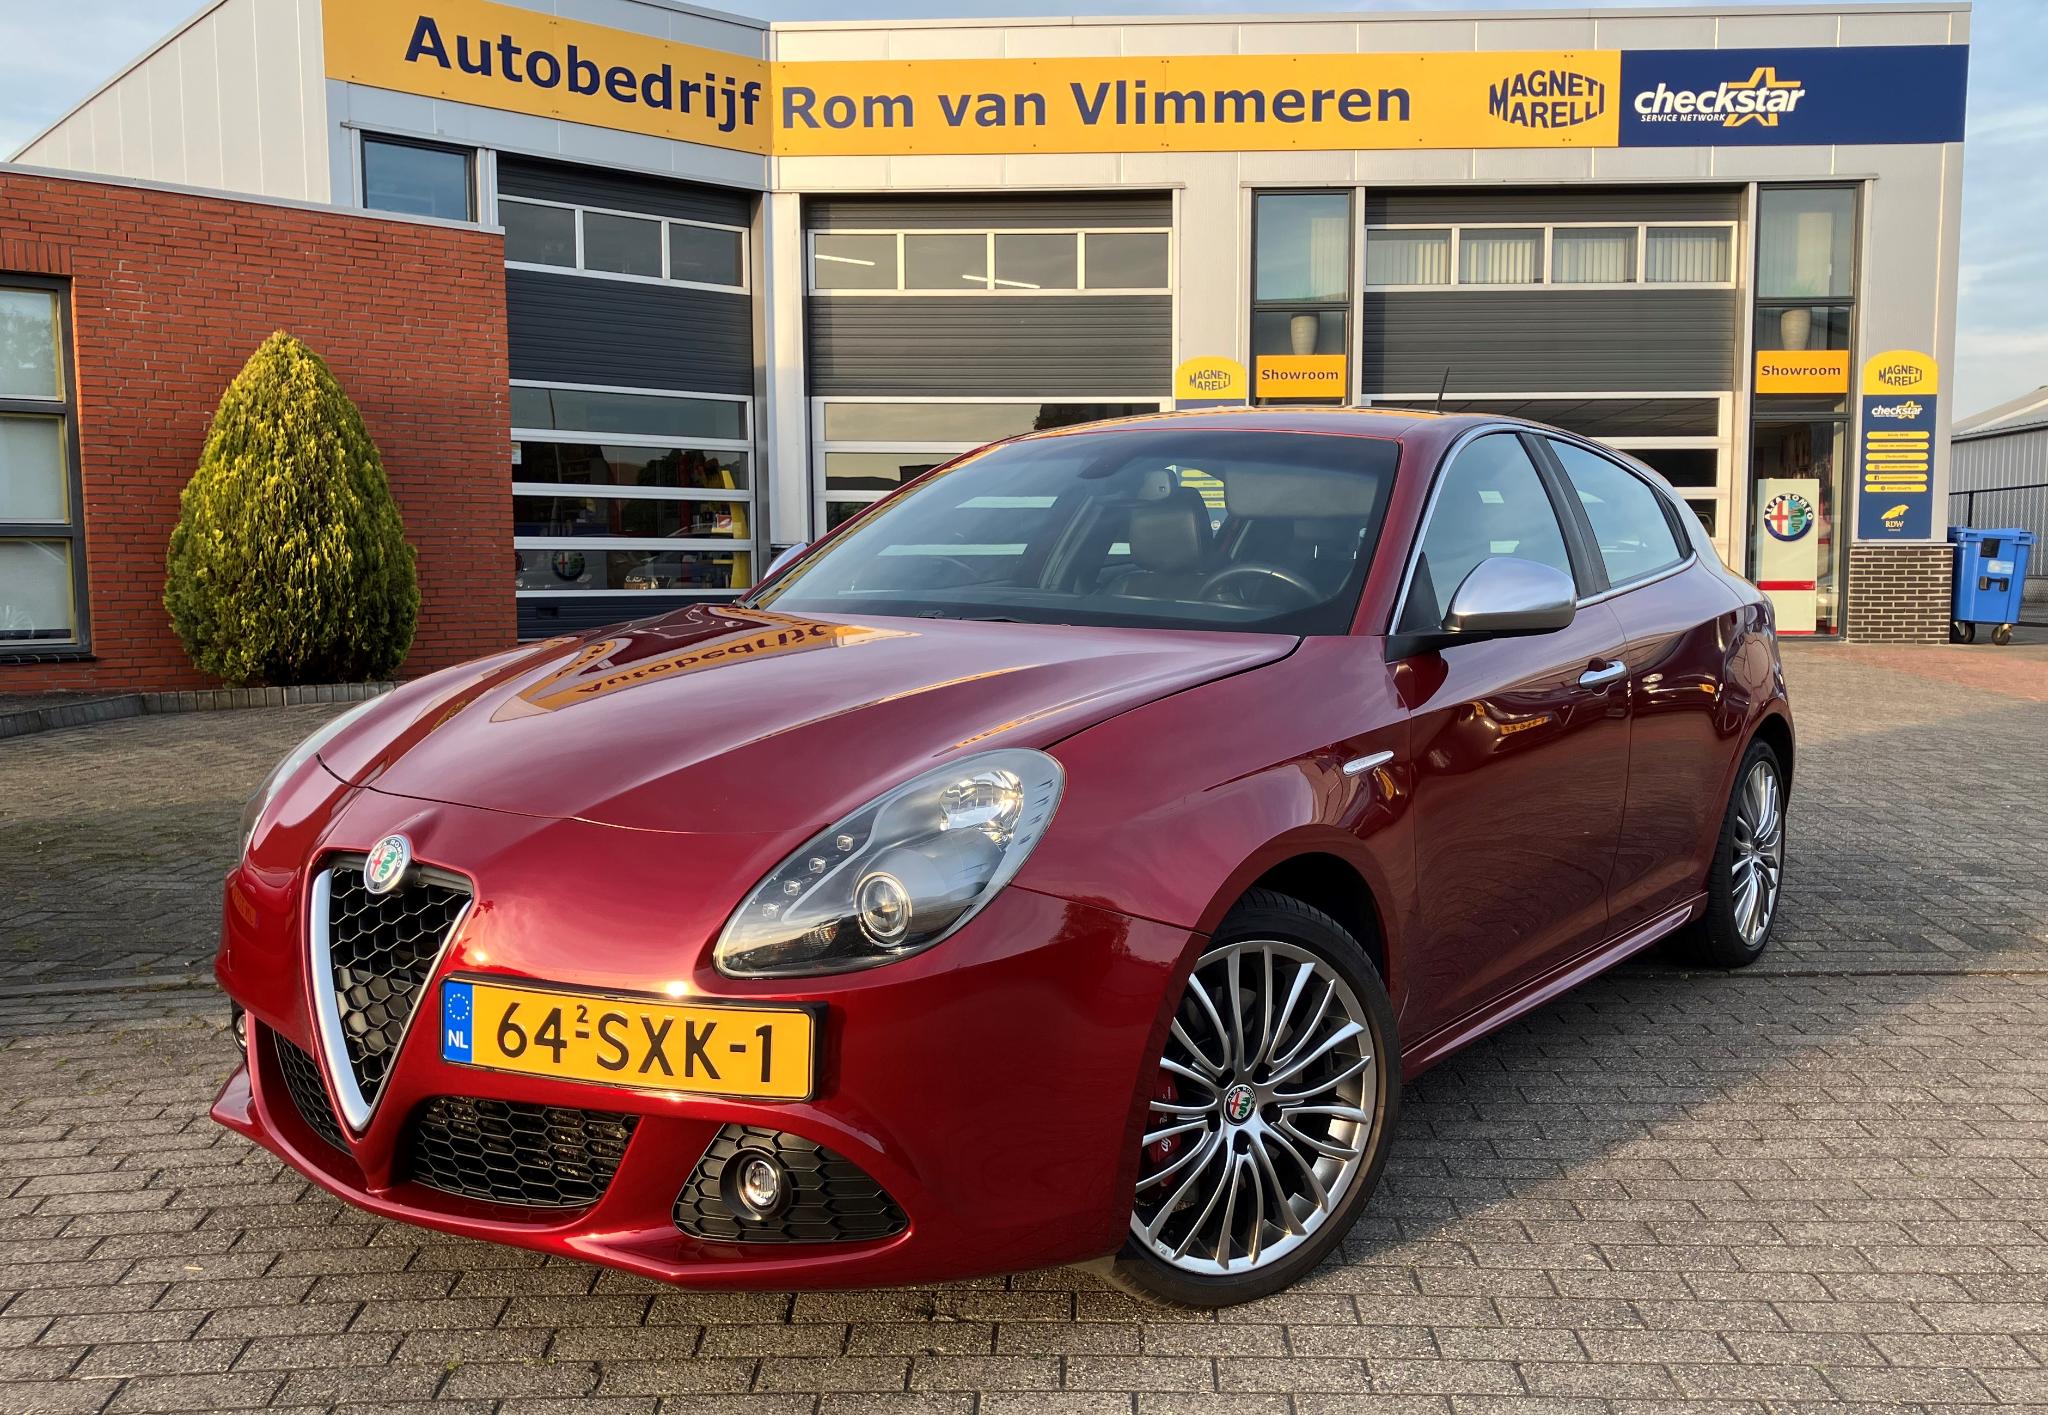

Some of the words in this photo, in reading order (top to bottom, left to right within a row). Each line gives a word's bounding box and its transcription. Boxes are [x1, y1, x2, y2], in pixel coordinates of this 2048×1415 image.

[404, 15, 762, 132] Autobedrijf
[782, 86, 914, 129] Rom
[938, 91, 1047, 128] van
[1070, 80, 1410, 125] Vlimmeren
[1489, 69, 1605, 114] MAGNETI
[1634, 82, 1806, 114] checkstar
[1489, 84, 1605, 128] MARELLI
[1641, 114, 1678, 122] SERVICE
[1680, 113, 1726, 122] NETWORK
[1189, 369, 1231, 386] MAGNETI
[1261, 368, 1339, 380] Showroom
[1761, 365, 1841, 376] Showroom
[1878, 364, 1923, 381] MAGNETI
[1878, 370, 1923, 386] MARELLI
[1189, 375, 1231, 391] MARELLI
[1871, 404, 1923, 415] checkstar
[1764, 494, 1783, 520] ALFA
[1784, 493, 1814, 521] ROMEO
[1885, 520, 1905, 528] RDW
[448, 1030, 469, 1050] NL
